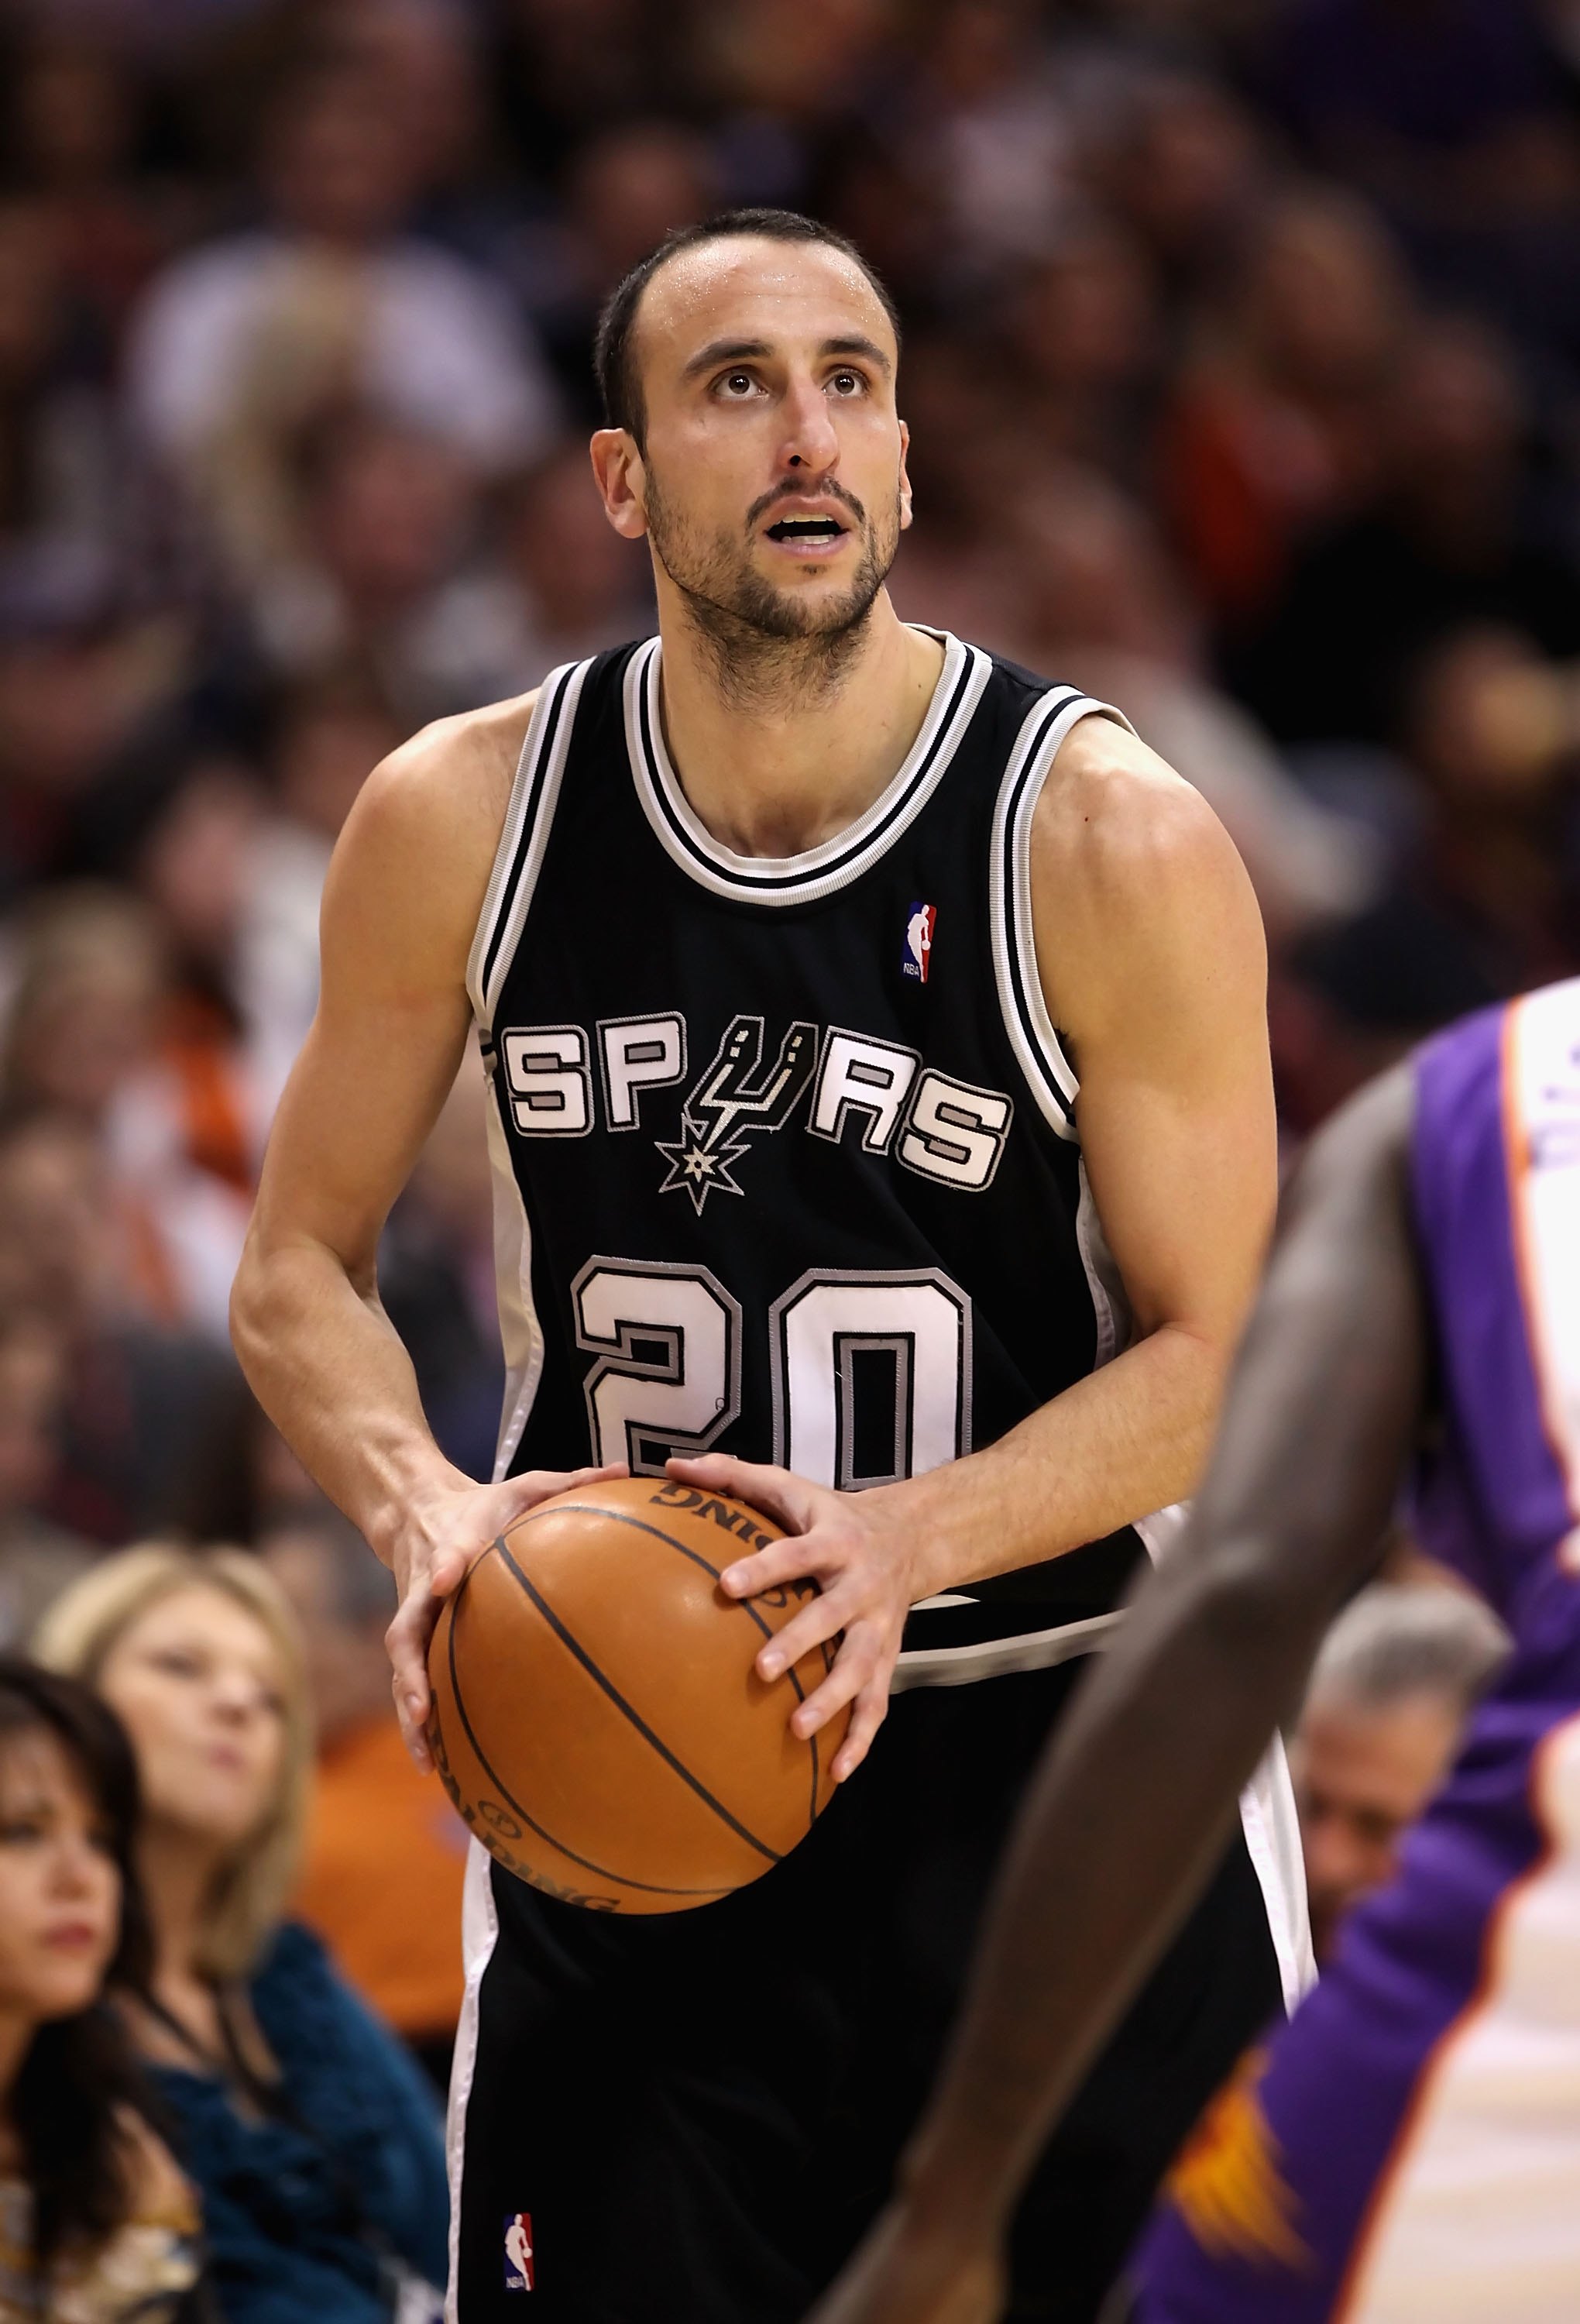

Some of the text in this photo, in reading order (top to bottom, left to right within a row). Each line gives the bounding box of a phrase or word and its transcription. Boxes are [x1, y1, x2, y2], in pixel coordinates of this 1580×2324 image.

[904, 963, 919, 976] NBA
[500, 1011, 1014, 1216] SPURS
[570, 1254, 973, 1492] 20
